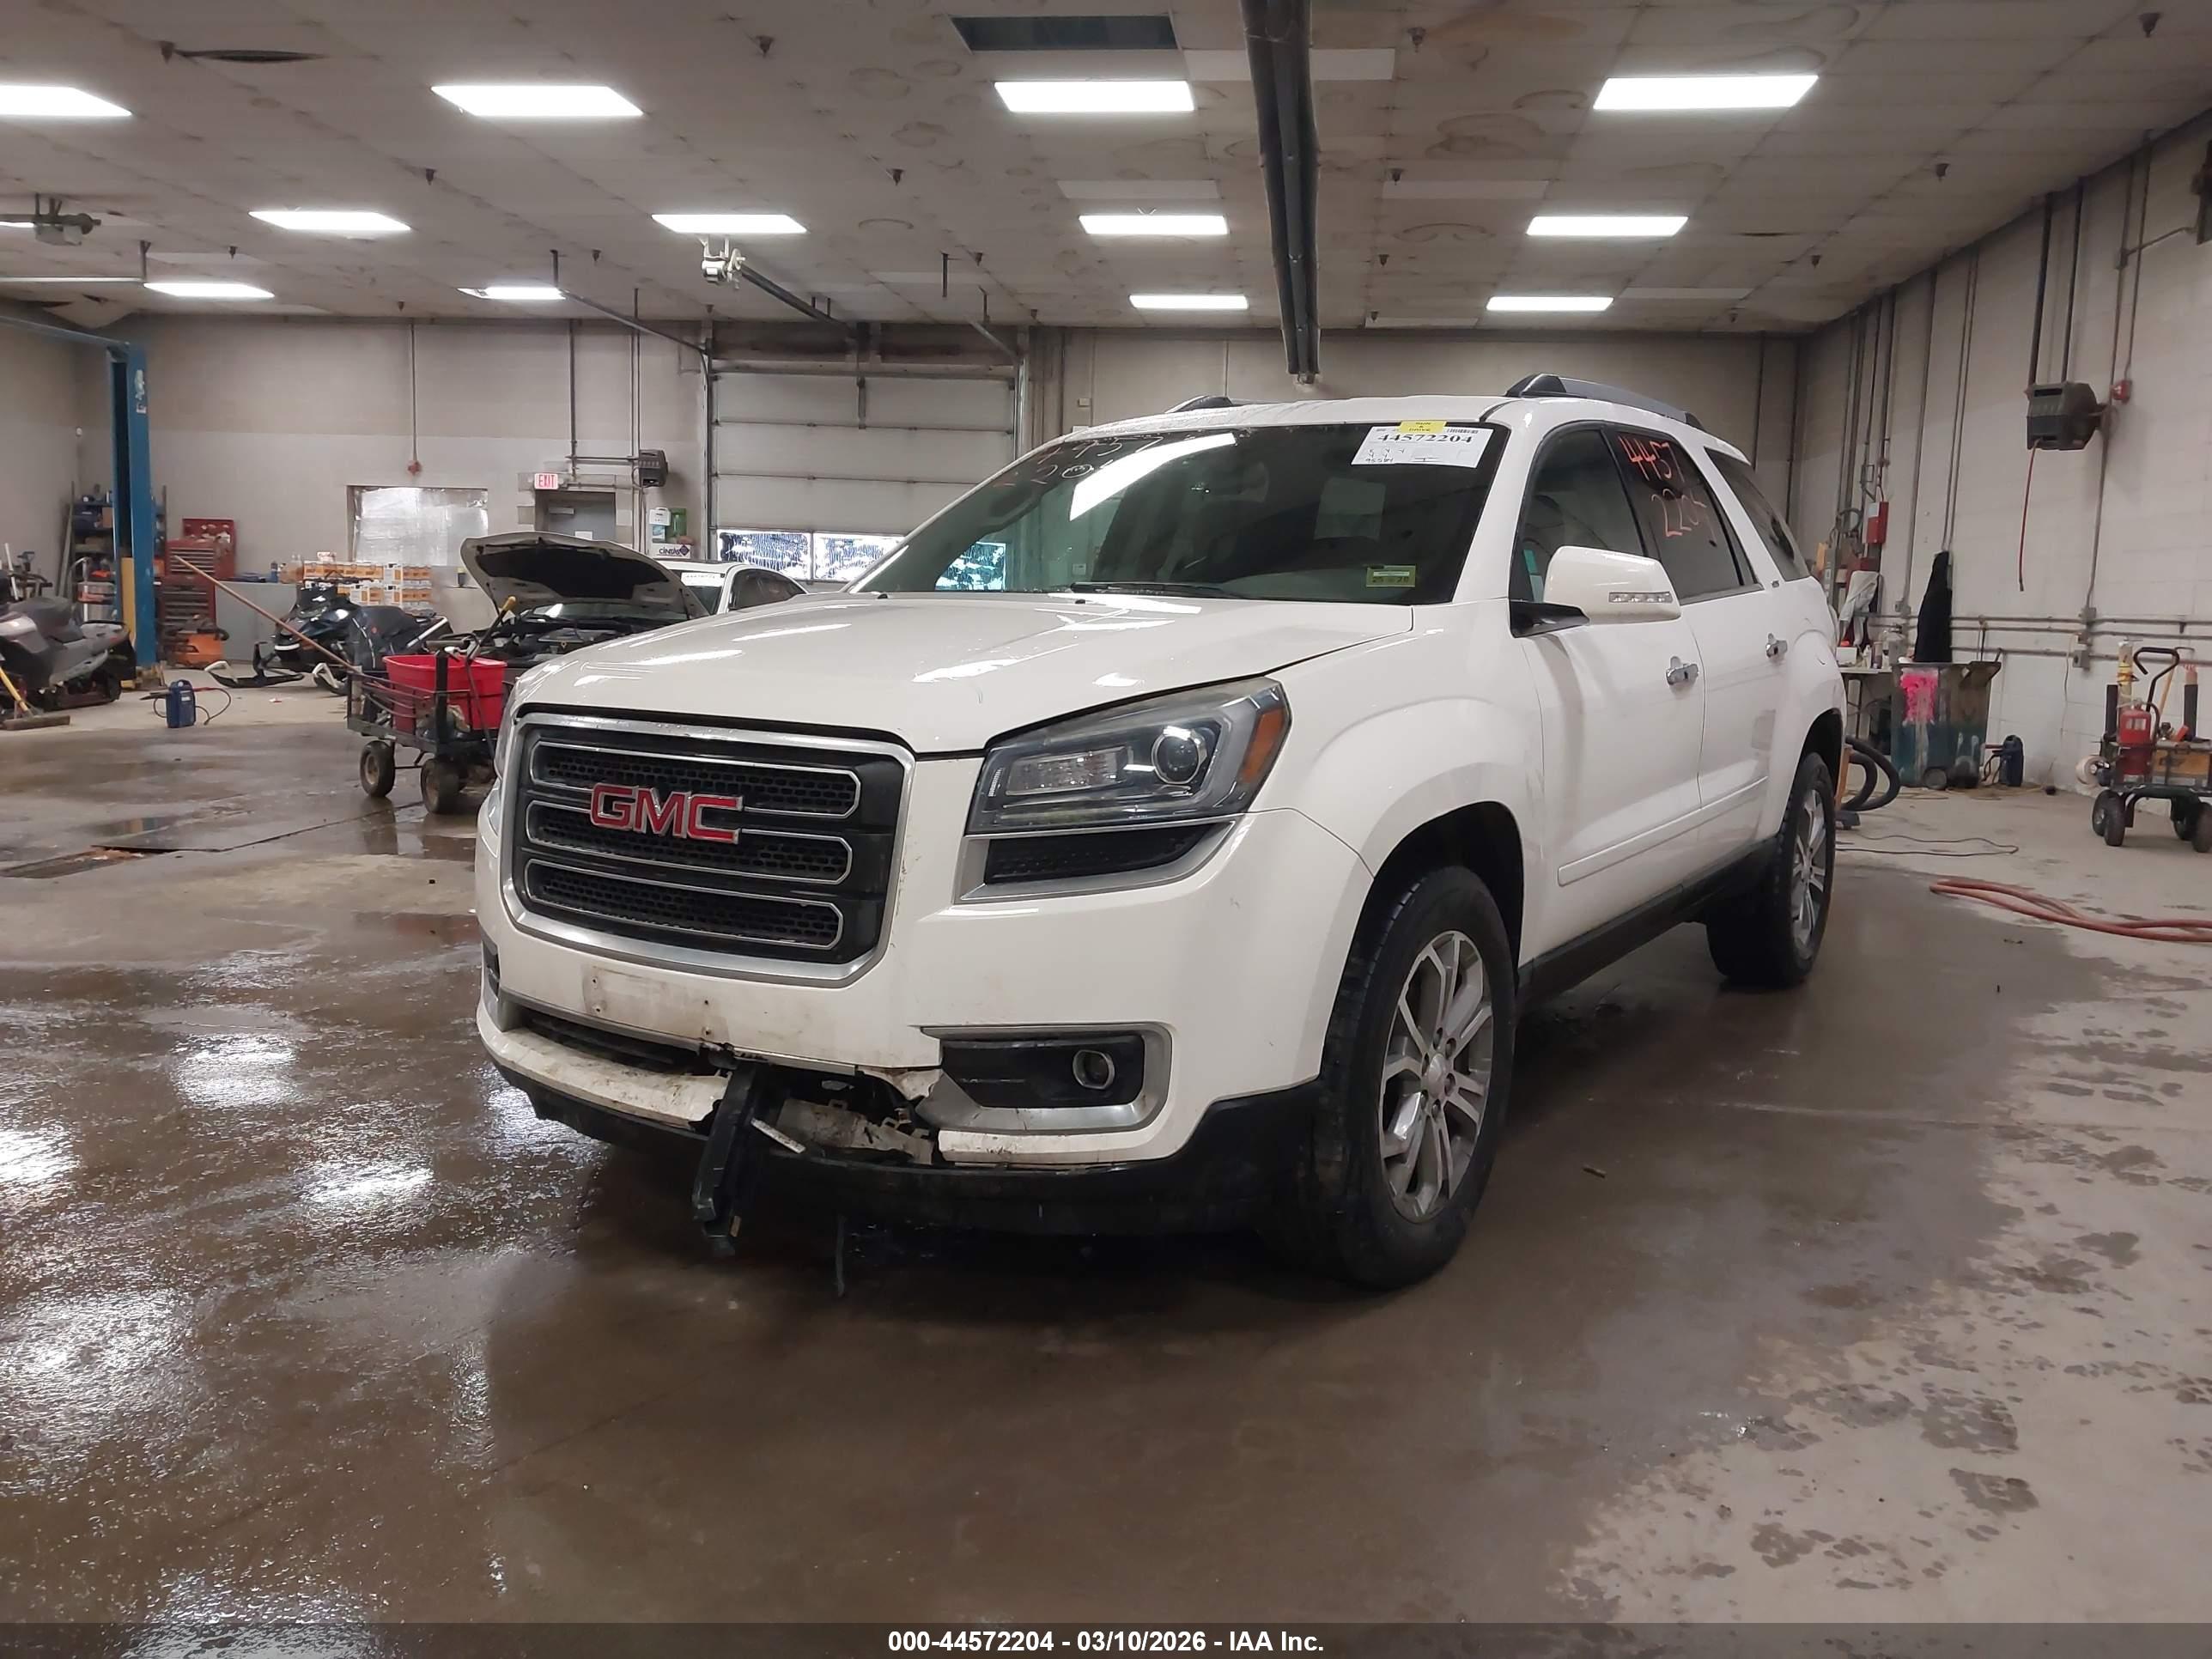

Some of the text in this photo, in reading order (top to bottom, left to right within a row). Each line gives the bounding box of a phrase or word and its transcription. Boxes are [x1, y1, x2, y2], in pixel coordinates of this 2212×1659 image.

[1377, 434, 1473, 443] 44572204
[1618, 435, 1685, 483] 4457
[538, 474, 556, 489] EXIT
[590, 782, 743, 844] GMC
